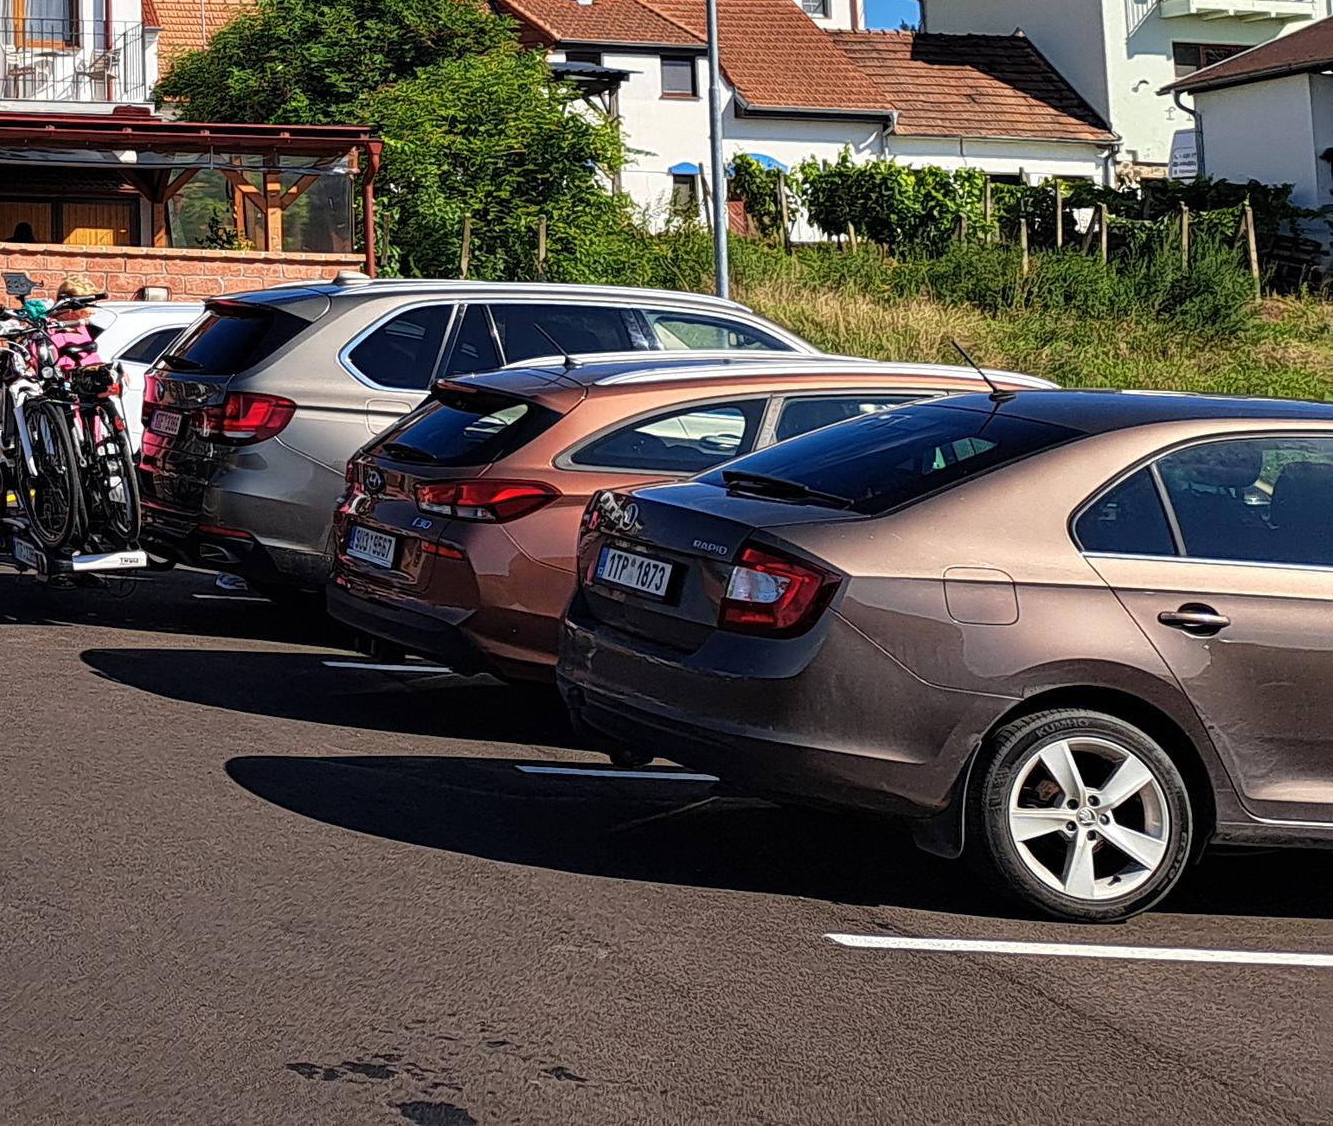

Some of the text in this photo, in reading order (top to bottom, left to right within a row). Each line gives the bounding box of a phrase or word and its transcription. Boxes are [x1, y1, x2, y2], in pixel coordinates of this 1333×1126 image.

[692, 539, 728, 555] RAPID
[607, 553, 666, 592] 1TP 1873
[1035, 719, 1089, 738] KUMHO
